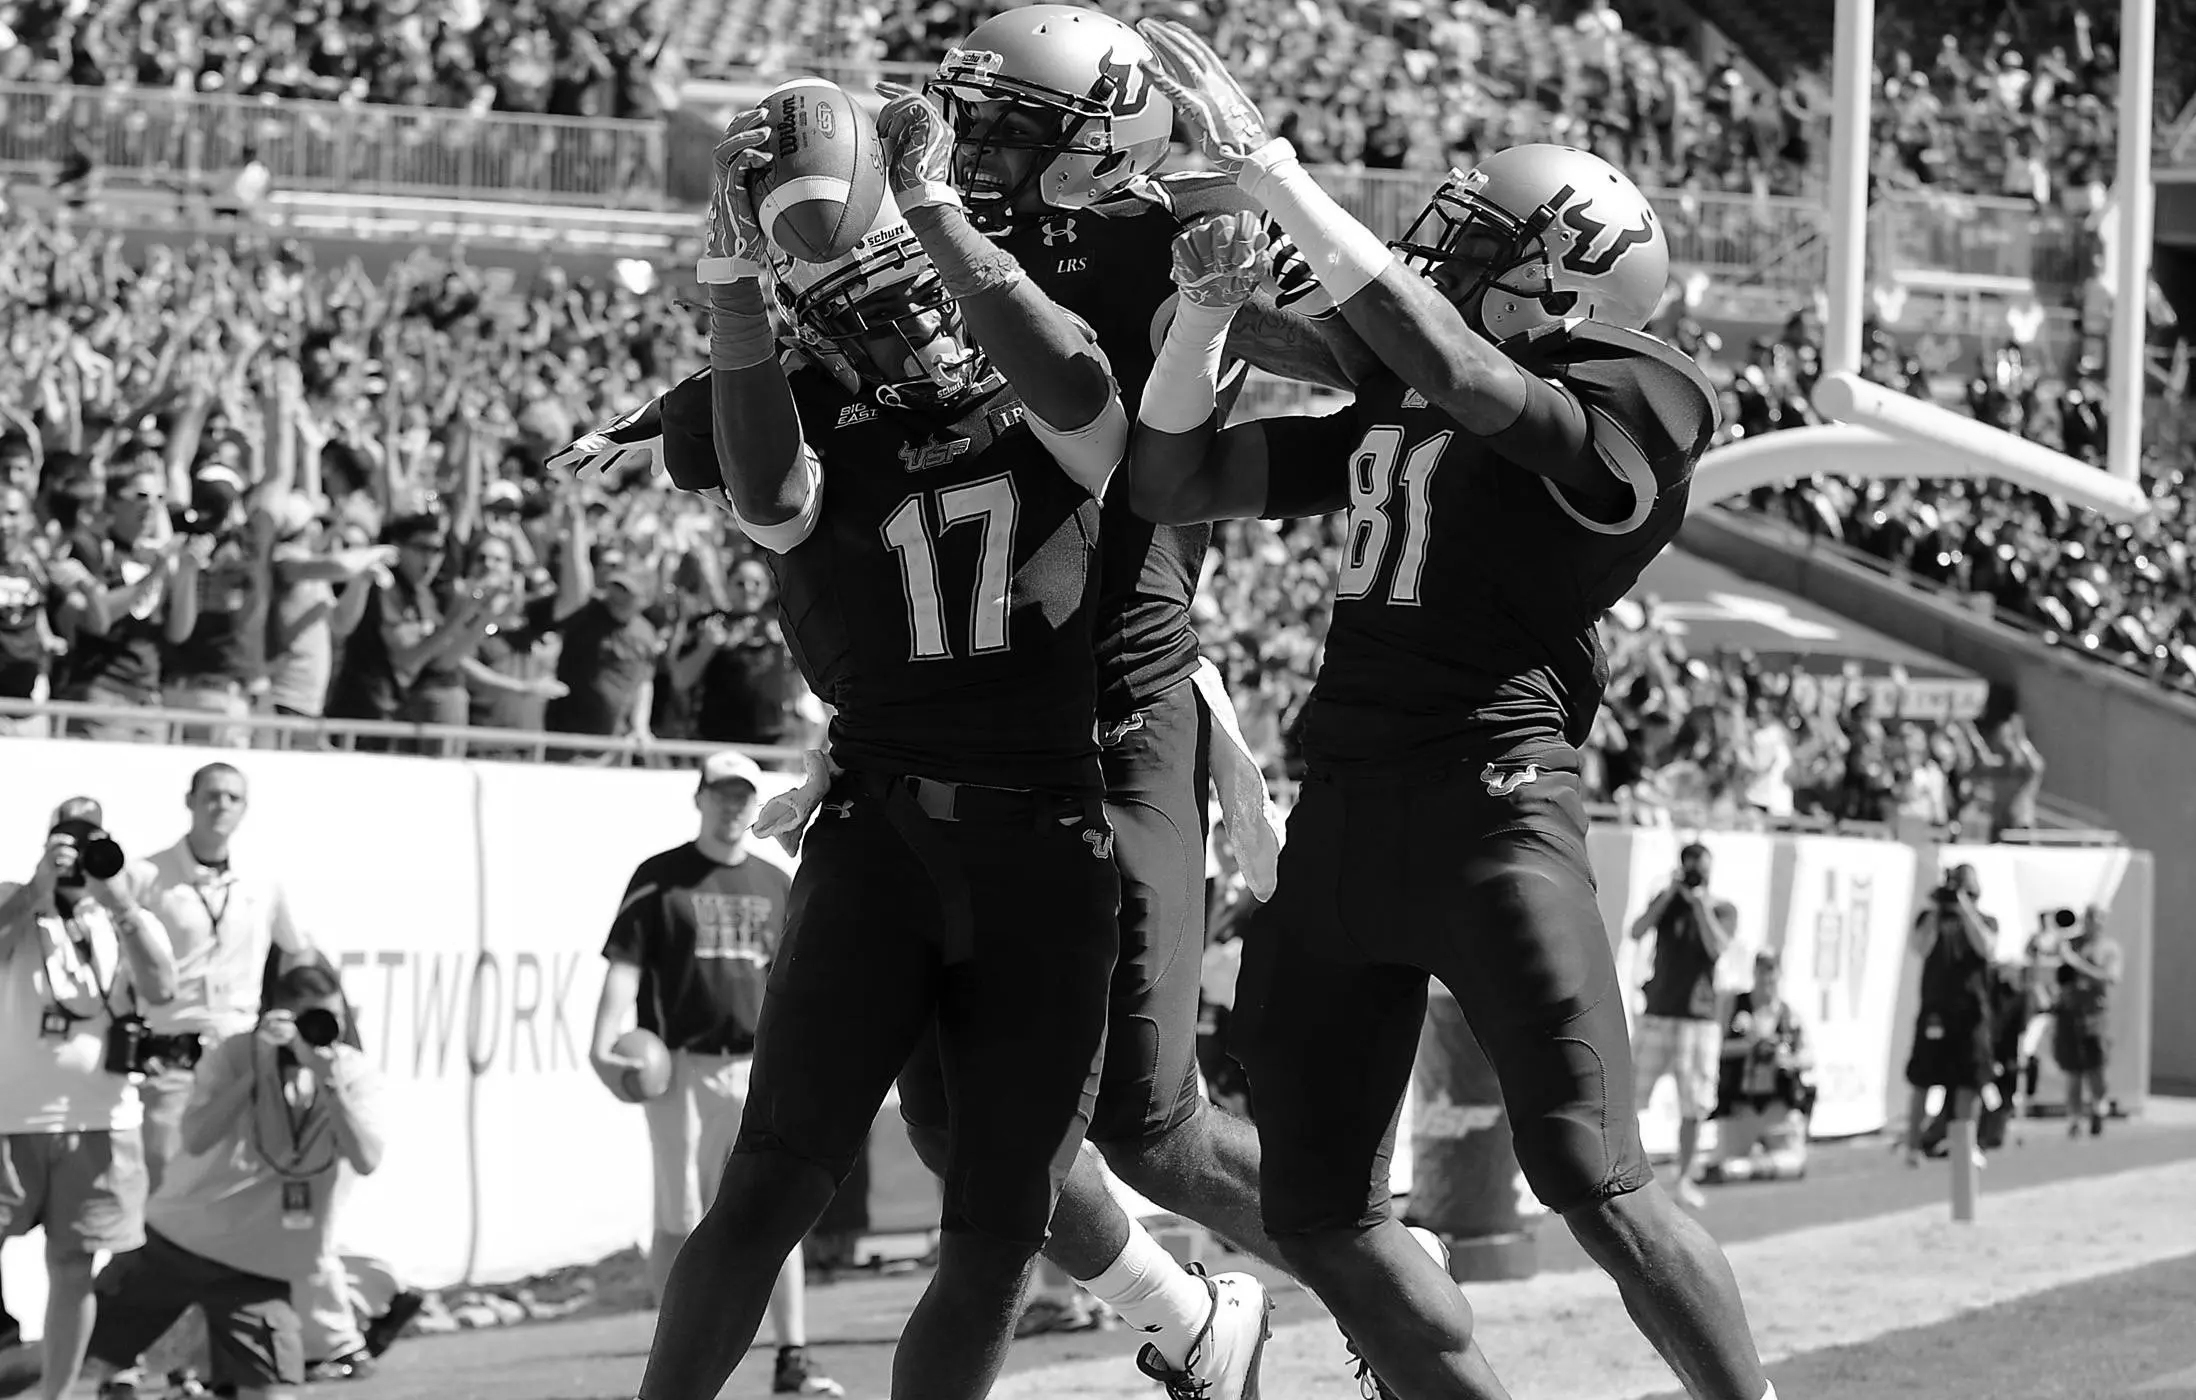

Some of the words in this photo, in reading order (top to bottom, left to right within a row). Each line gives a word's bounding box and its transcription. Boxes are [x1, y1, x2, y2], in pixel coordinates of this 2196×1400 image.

[778, 94, 798, 159] Wilson
[1057, 257, 1087, 273] LRS
[837, 409, 877, 425] EAST
[840, 402, 867, 416] BIG
[1000, 407, 1025, 427] LR
[898, 434, 971, 472] USF
[1335, 425, 1454, 607] 81
[880, 471, 1020, 662] 17
